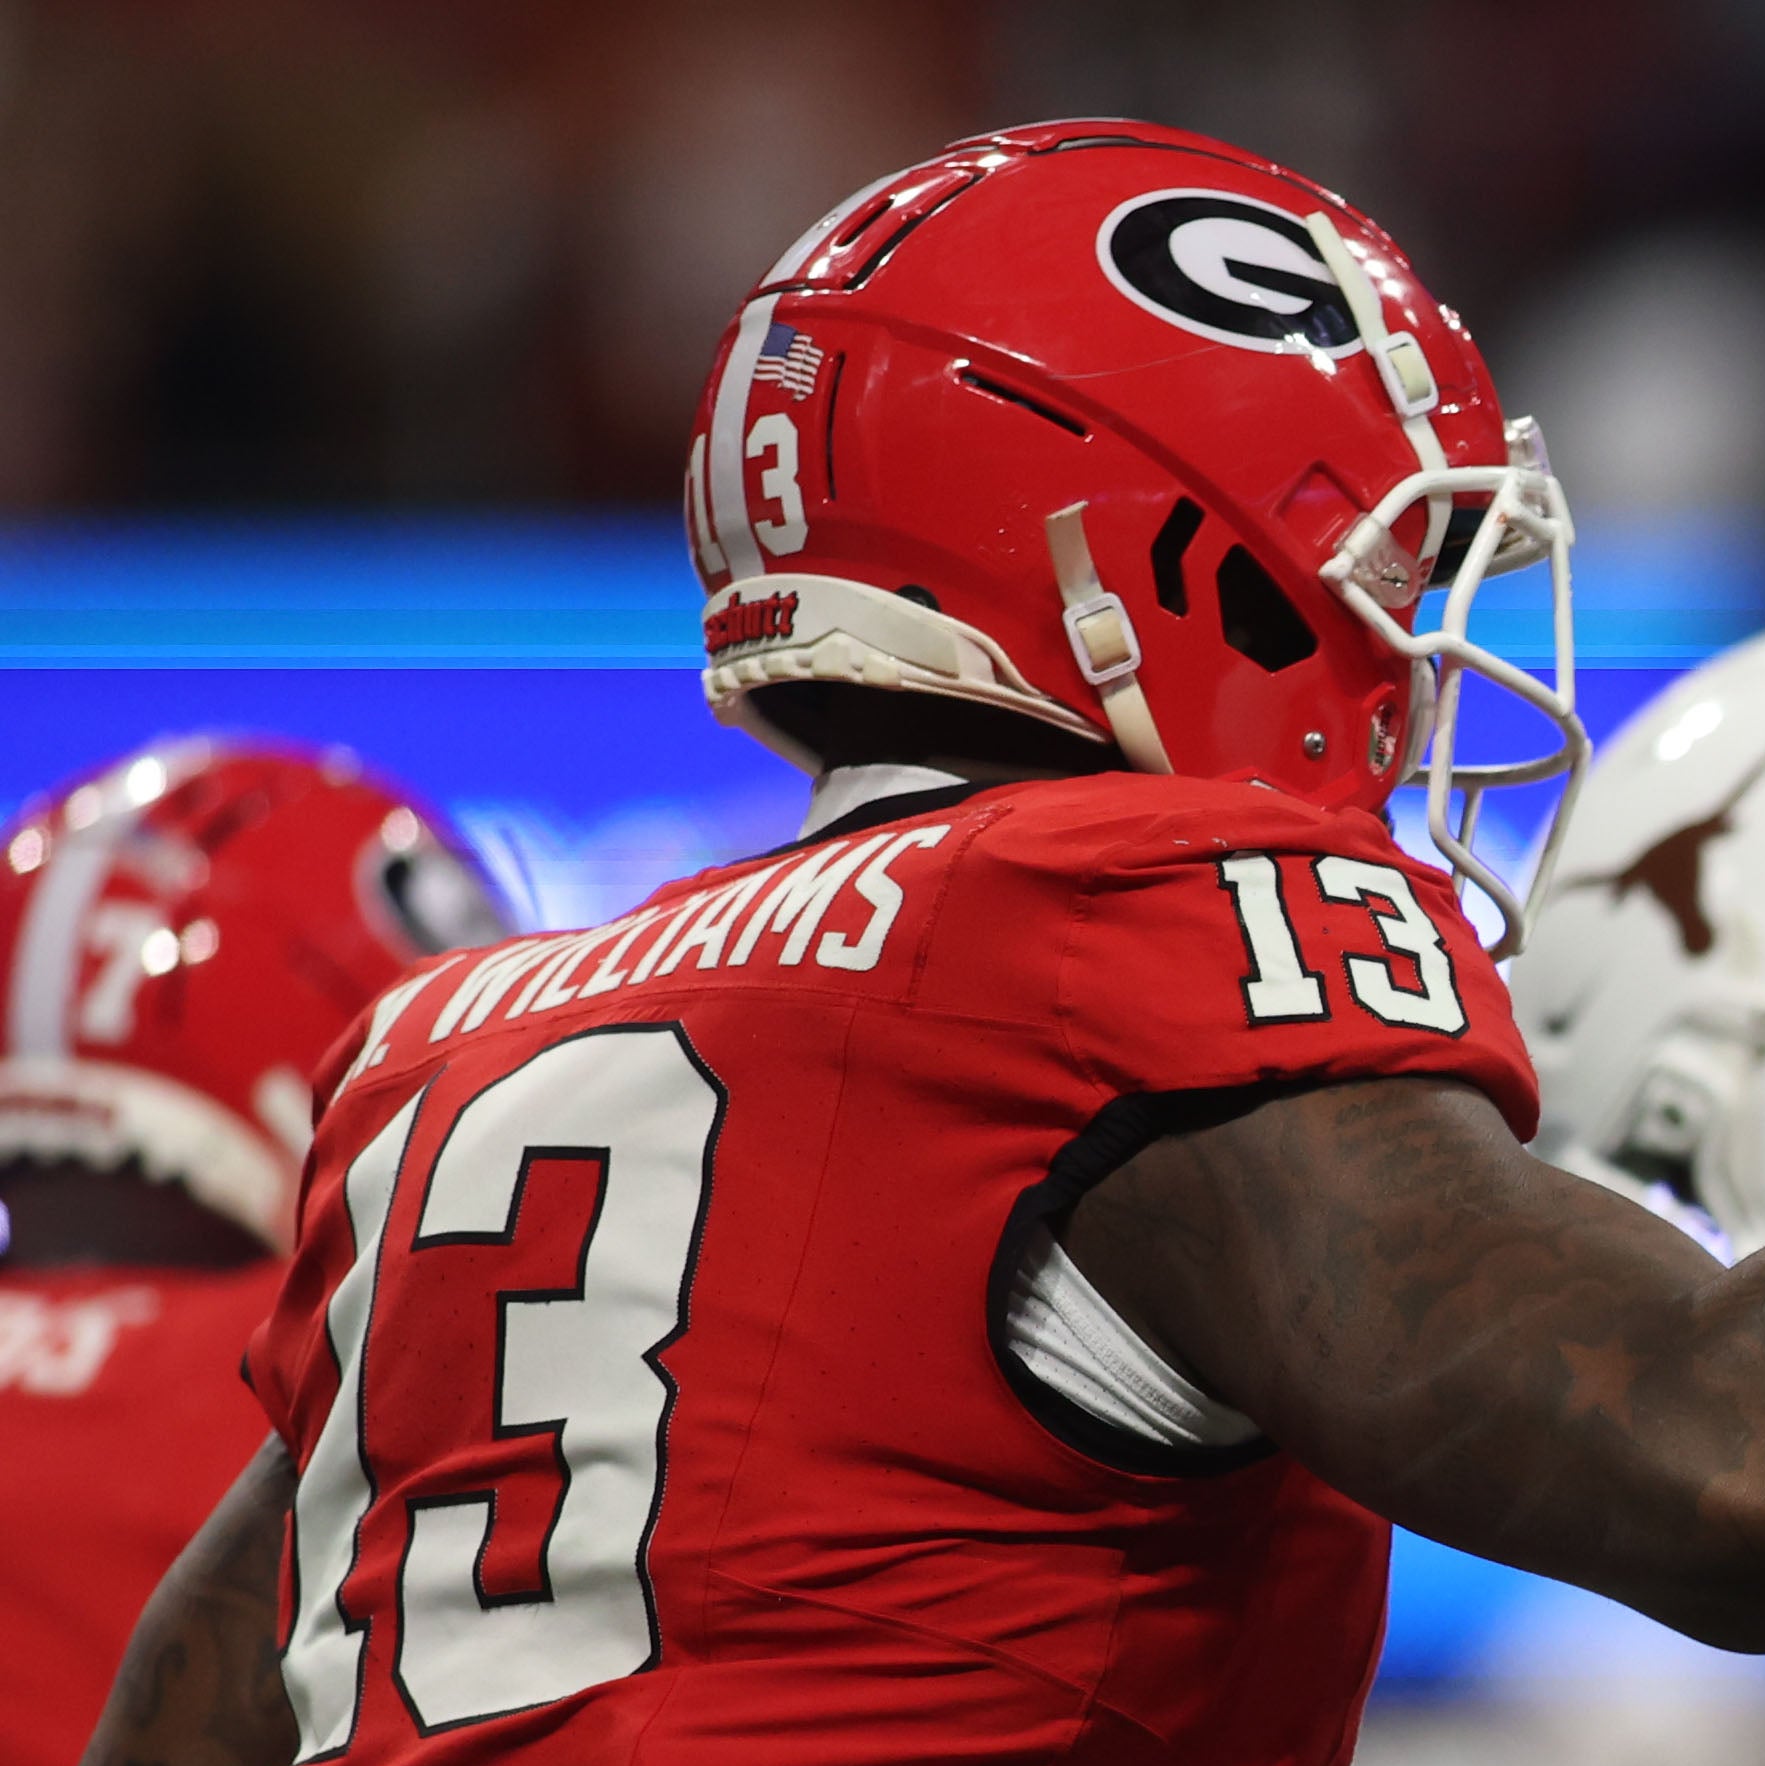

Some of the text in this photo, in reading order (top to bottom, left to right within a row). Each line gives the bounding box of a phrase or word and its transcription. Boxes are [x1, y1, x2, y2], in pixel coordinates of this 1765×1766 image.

[690, 412, 809, 575] 13
[428, 823, 952, 1044] WILLIAMS
[1214, 848, 1471, 1040] 13
[279, 1020, 729, 1766] 13
